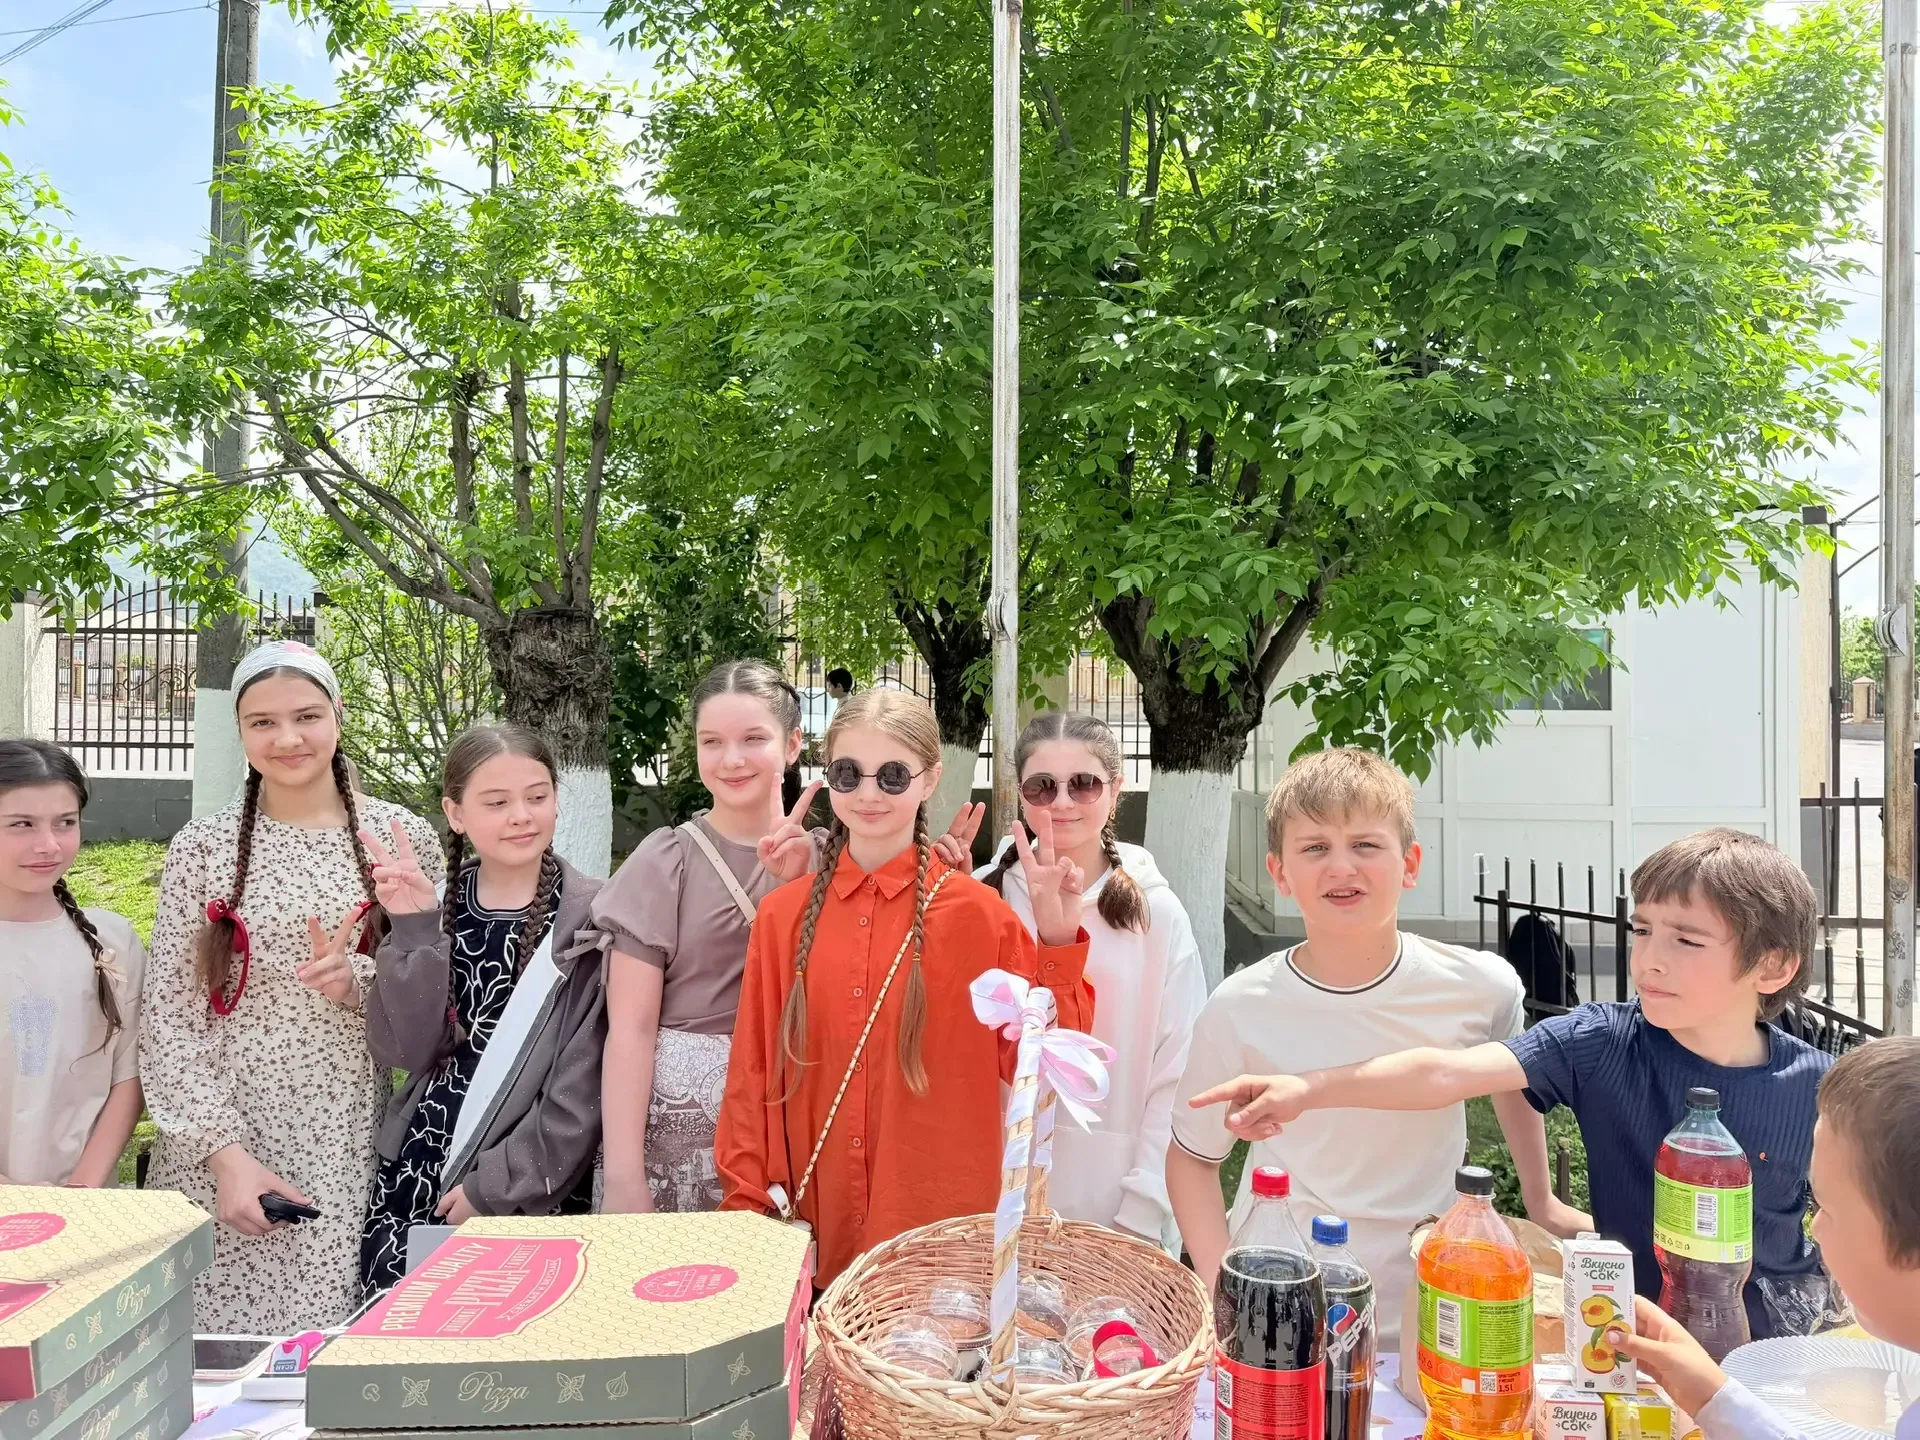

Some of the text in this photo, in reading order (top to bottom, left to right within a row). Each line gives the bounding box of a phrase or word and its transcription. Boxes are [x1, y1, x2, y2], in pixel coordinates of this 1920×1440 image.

[1580, 1257, 1626, 1273] Вкусно
[116, 1281, 152, 1318] Pizza
[379, 1242, 493, 1332] PREMIUM QUALITY
[443, 1269, 532, 1307] PIZZA
[84, 1349, 122, 1389] Pizza
[458, 1371, 530, 1413] Pizza
[80, 1403, 120, 1440] Pizza
[1552, 1406, 1598, 1424] Вкусно
